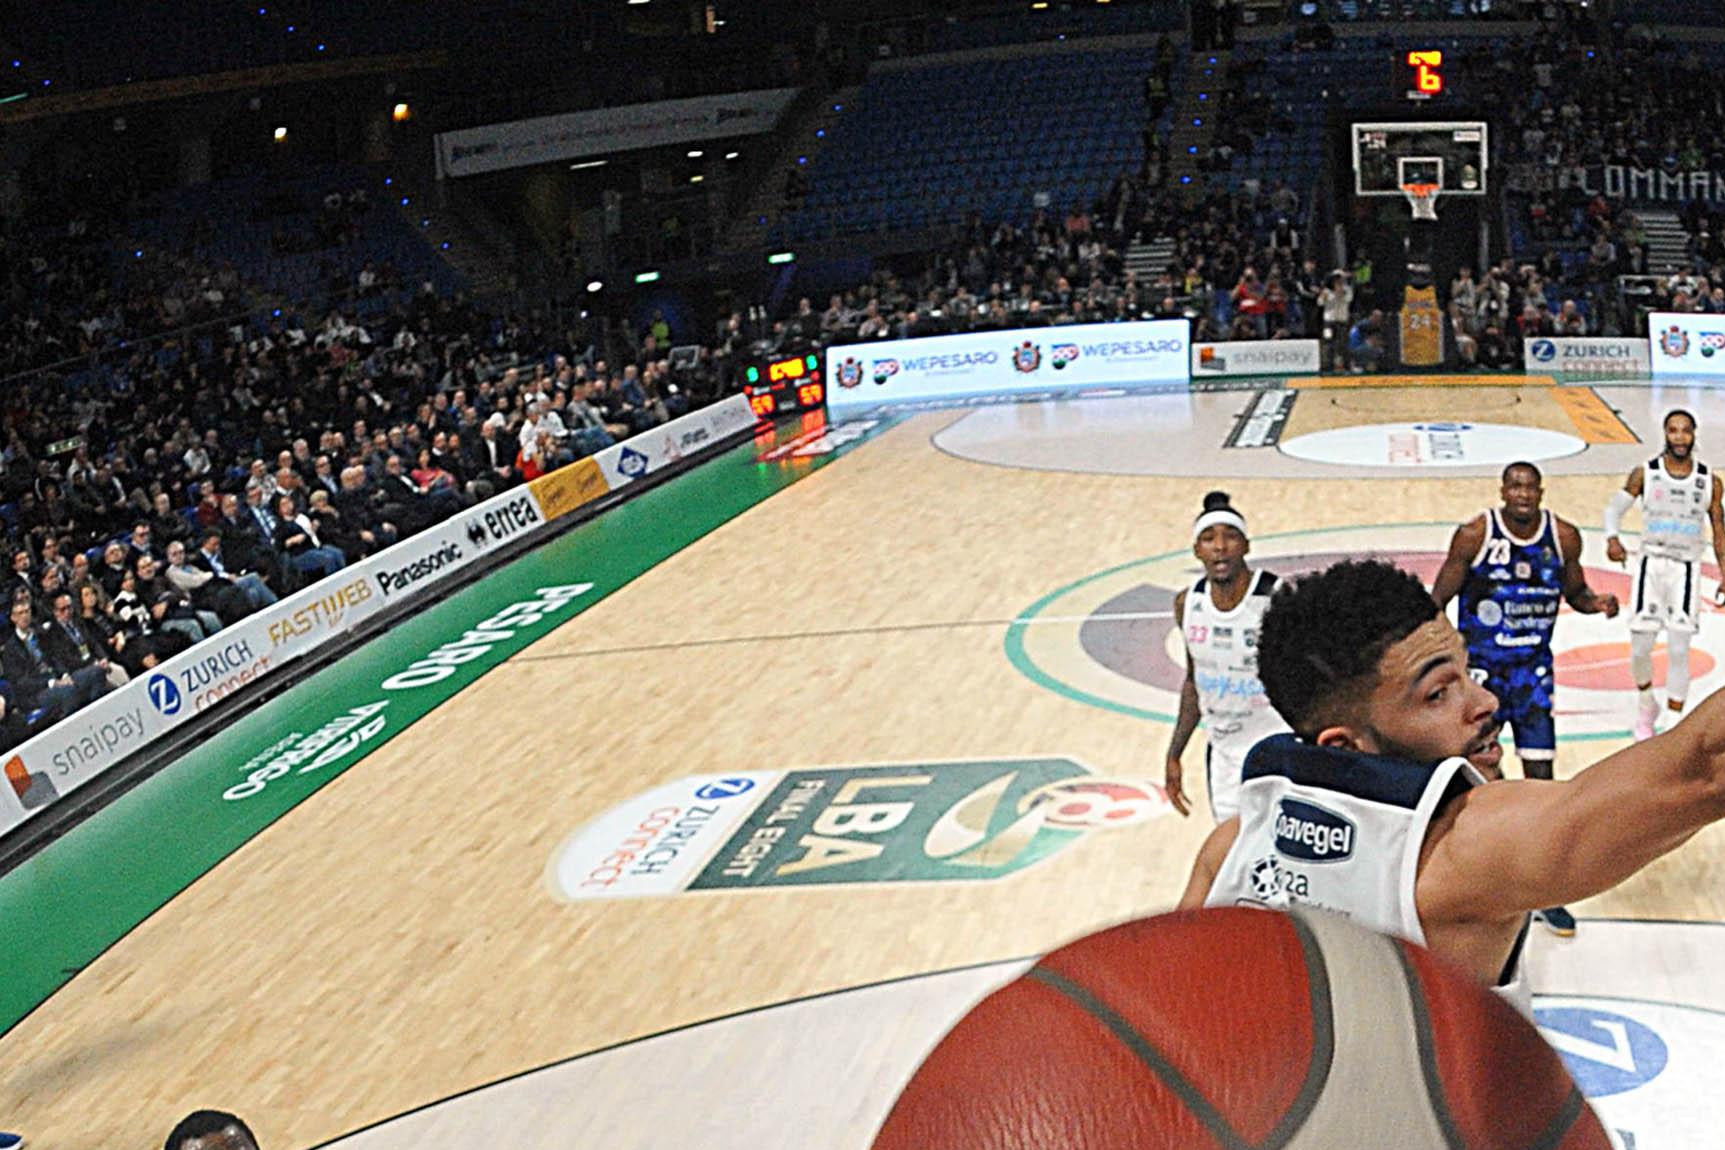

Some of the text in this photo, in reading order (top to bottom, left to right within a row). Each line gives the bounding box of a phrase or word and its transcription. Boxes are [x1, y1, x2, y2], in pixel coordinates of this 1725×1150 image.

[902, 351, 1000, 372] WEPESARO
[1082, 338, 1183, 358] WEPESARO
[1562, 344, 1632, 358] ZURICH
[376, 541, 464, 597] Panasonic
[181, 639, 254, 692] ZURICH
[381, 581, 594, 689] PESARO
[52, 708, 146, 776] snaipay
[579, 806, 683, 890] connect
[629, 804, 721, 877] ZURICH
[721, 779, 826, 880] FINAL EIGHT
[776, 772, 935, 877] LBA
